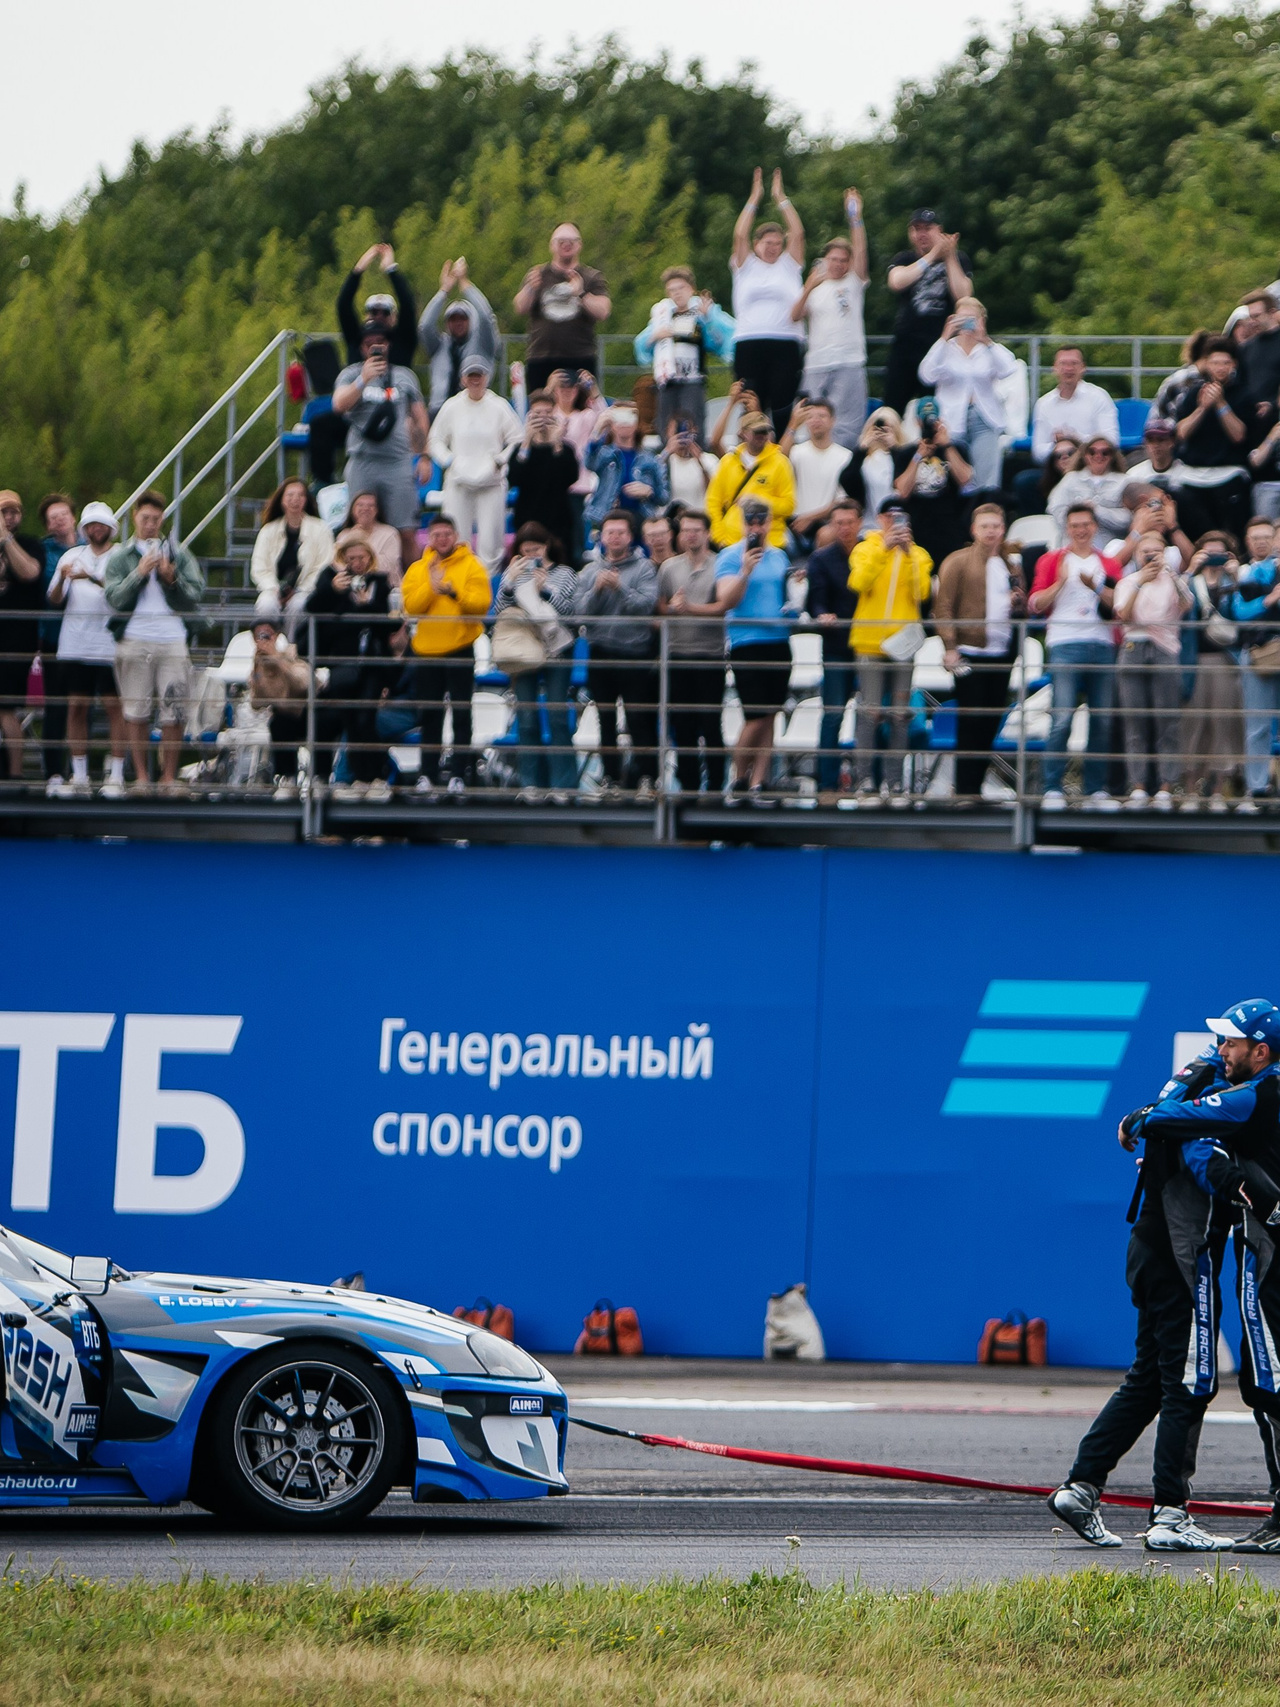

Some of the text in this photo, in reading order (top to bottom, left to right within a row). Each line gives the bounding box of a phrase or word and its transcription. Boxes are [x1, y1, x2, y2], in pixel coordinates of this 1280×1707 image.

[379, 1018, 713, 1089] Генеральный
[372, 1111, 582, 1172] спонсор
[159, 1296, 237, 1307] E. LOSEV
[1246, 1271, 1257, 1320] RACING
[1200, 1326, 1209, 1375] RACING
